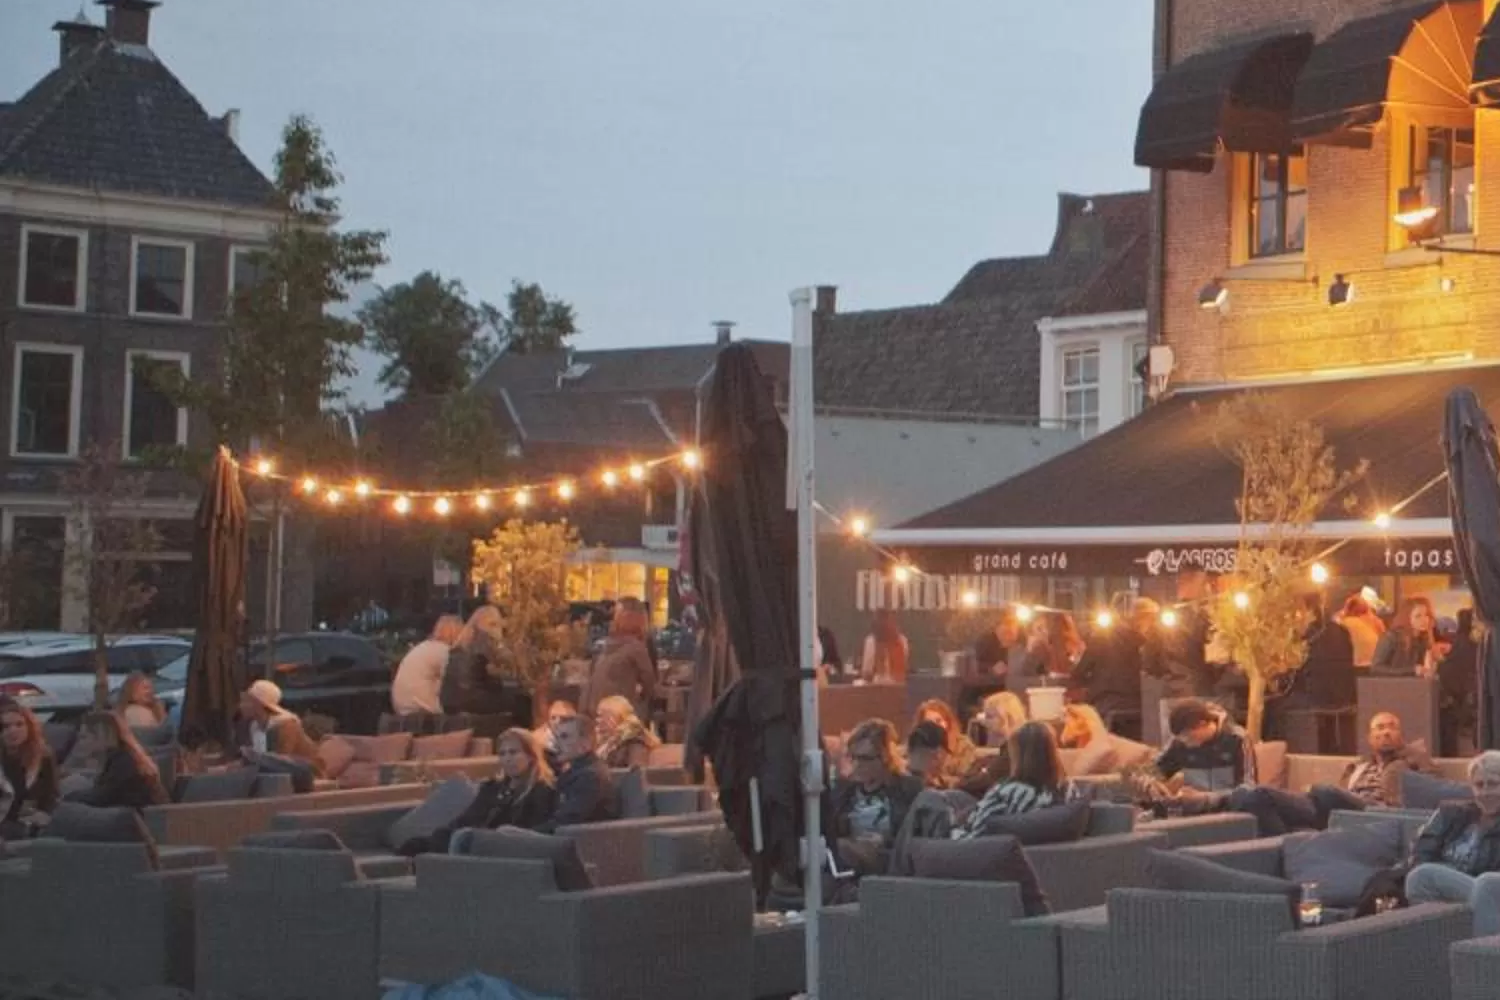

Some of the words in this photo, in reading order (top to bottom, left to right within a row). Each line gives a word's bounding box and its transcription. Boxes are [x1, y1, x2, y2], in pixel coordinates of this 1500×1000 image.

[973, 551, 1021, 573] grand
[1029, 551, 1068, 569] café
[1383, 547, 1454, 572] tapas
